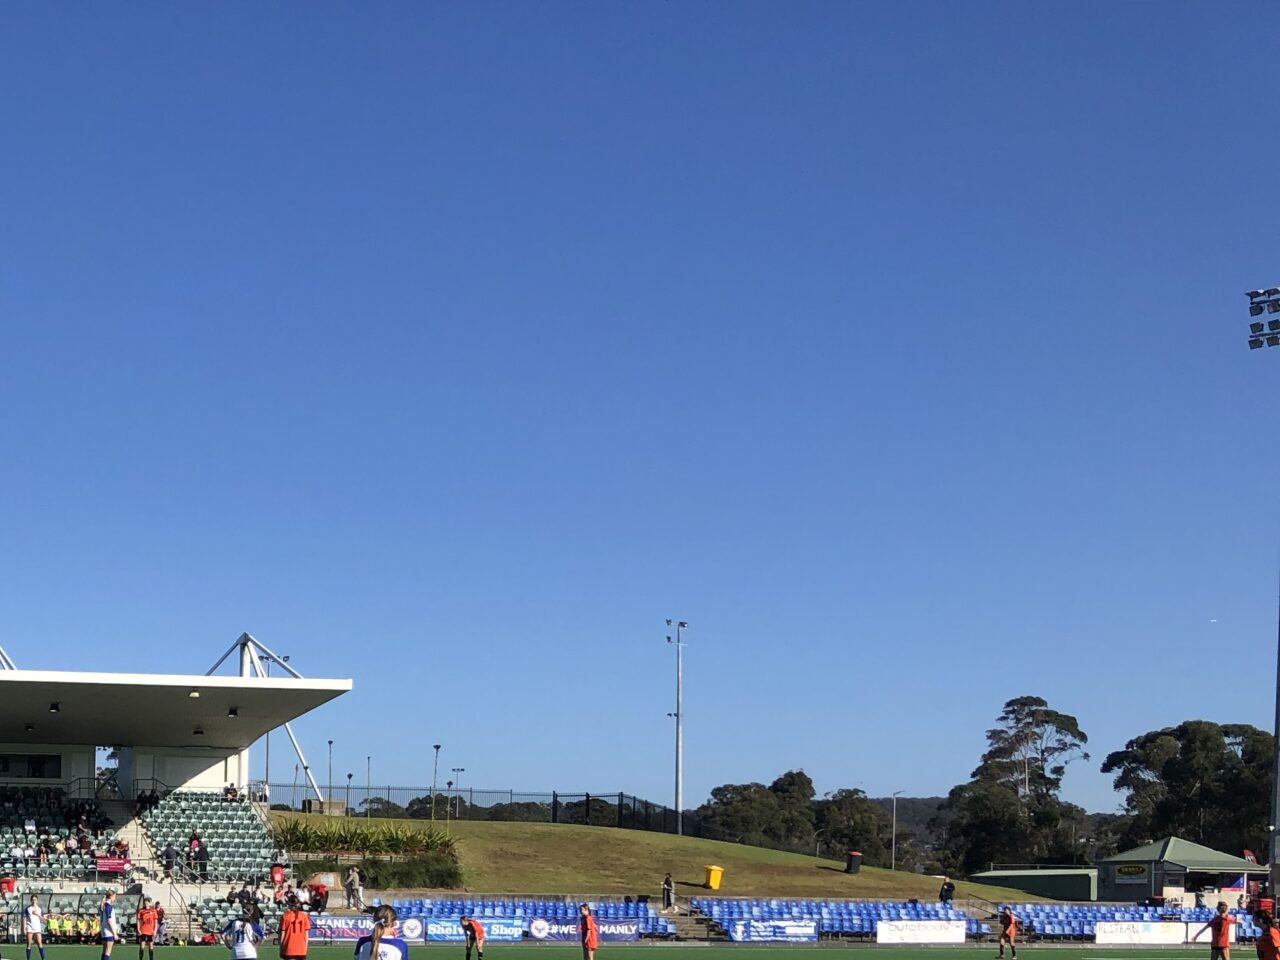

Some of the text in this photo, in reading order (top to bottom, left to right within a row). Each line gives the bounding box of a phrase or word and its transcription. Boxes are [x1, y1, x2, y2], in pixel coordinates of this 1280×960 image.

[291, 919, 303, 934] 11
[316, 919, 354, 929] MANLY
[551, 924, 577, 934] #WE
[600, 924, 638, 934] MANLY
[491, 923, 523, 938] Shop
